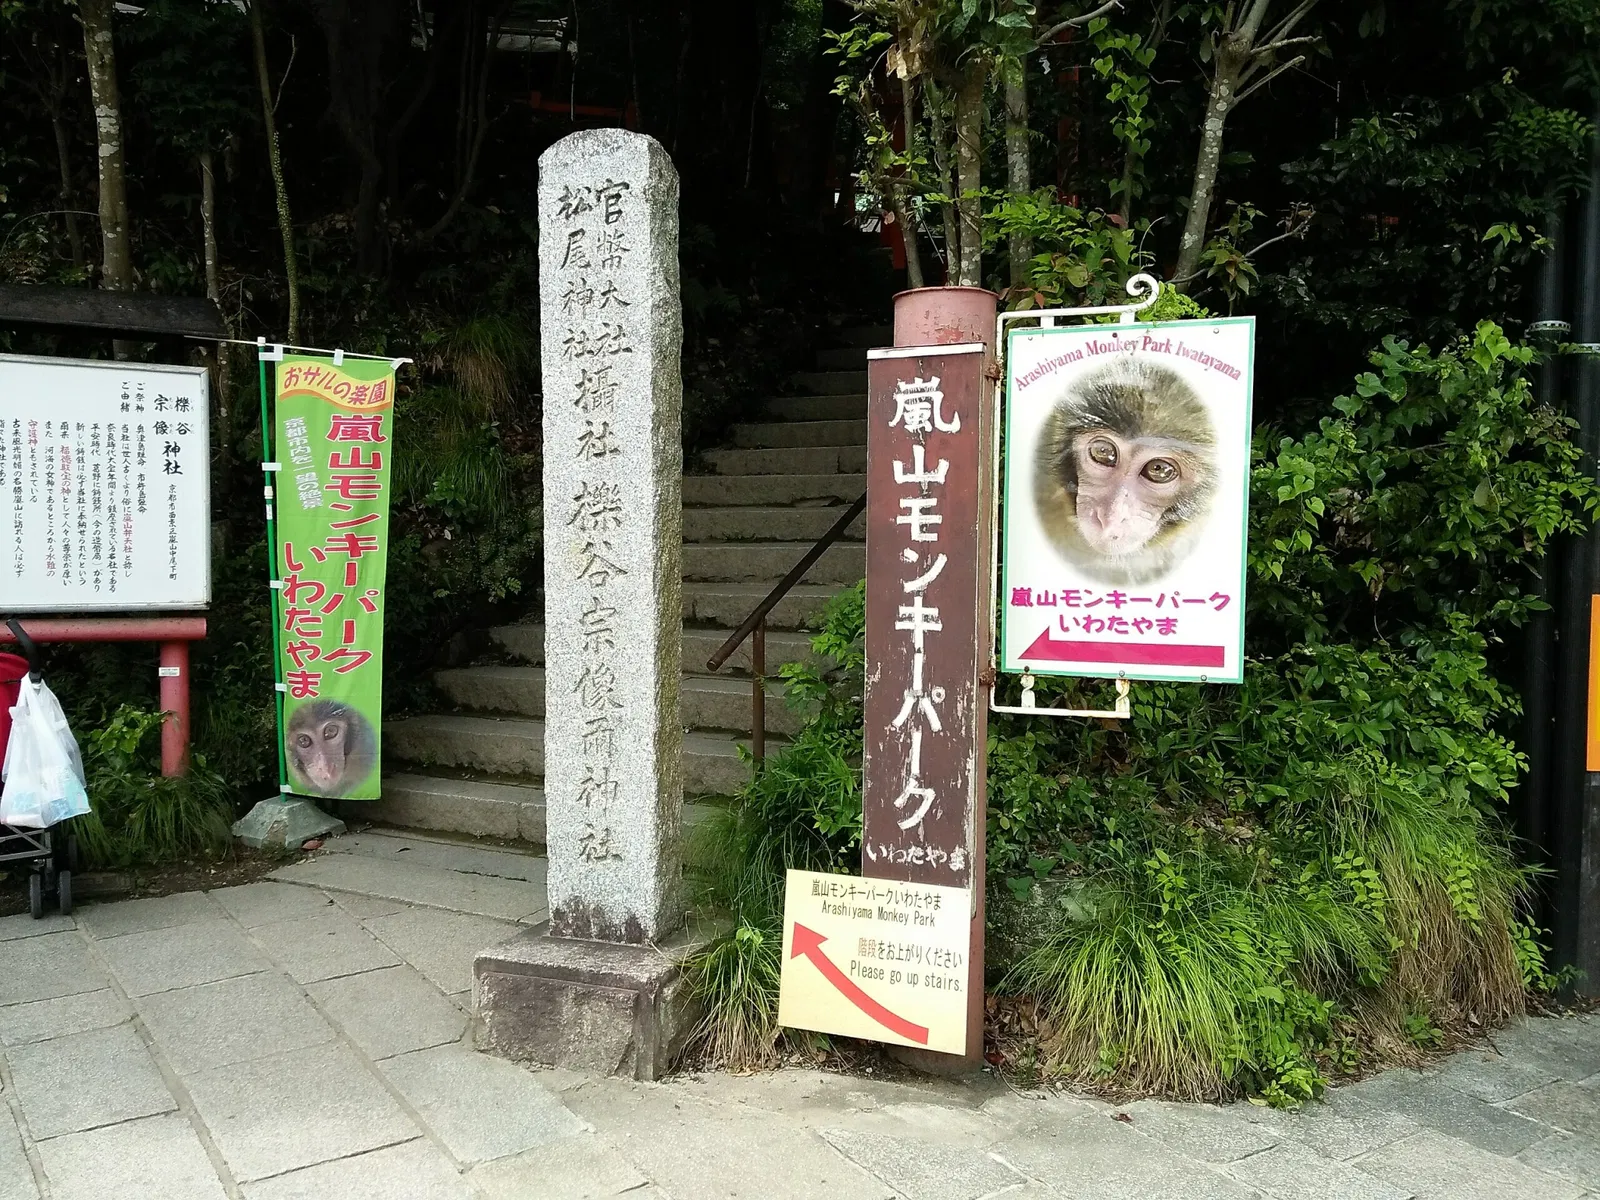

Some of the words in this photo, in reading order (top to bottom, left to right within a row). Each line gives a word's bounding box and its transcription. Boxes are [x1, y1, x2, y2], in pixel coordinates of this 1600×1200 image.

[1014, 348, 1084, 391] Arashiyama
[1085, 337, 1139, 357] Monkey
[1142, 335, 1173, 352] Park
[1175, 341, 1242, 381] Iwatayama
[284, 366, 387, 405] おサルの楽園
[162, 441, 184, 476] 神社
[320, 414, 388, 674] 嵐山モンキーパーク
[889, 376, 961, 831] 嵐山モンキーパーク
[1010, 587, 1232, 611] 嵐山モンキーパーク
[283, 542, 327, 699] いわたやま
[1059, 614, 1179, 636] いわたやま
[866, 843, 968, 872] いわたやま
[811, 878, 942, 911] 嵐山モンキーパークいわたやま
[821, 900, 873, 920] Arashiyama
[877, 906, 909, 927] Monkey
[914, 910, 936, 928] Park
[857, 937, 963, 969] 階段をお上がりください
[850, 960, 885, 981] Please
[889, 970, 902, 985] go
[906, 972, 919, 988] up
[924, 973, 963, 992] stairs.
